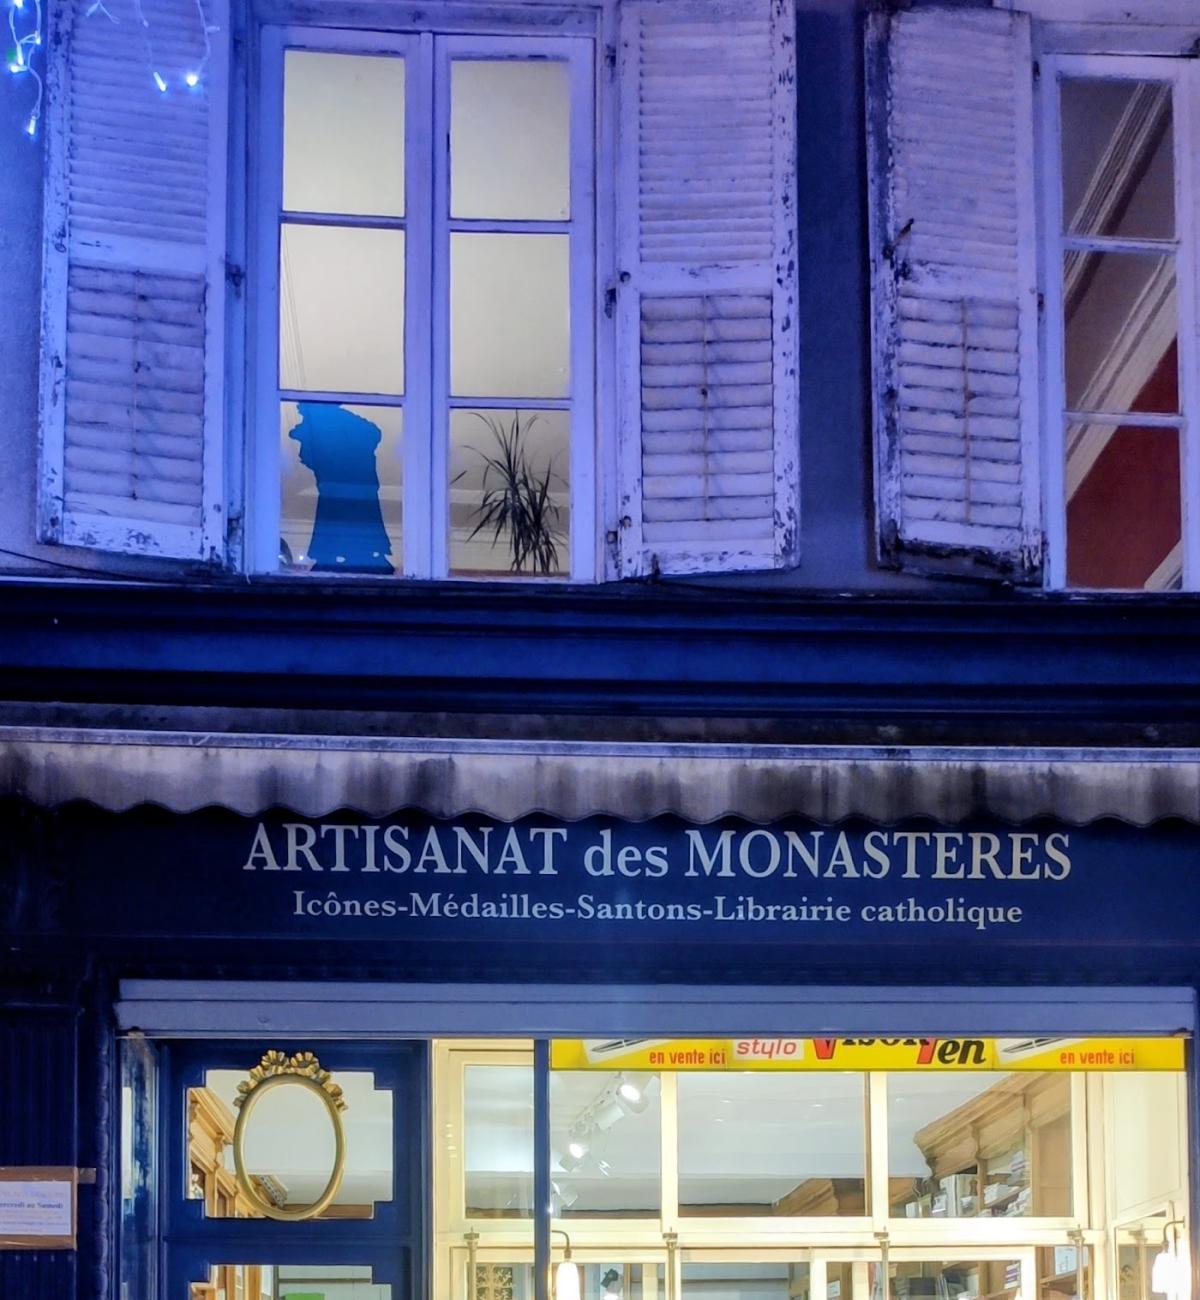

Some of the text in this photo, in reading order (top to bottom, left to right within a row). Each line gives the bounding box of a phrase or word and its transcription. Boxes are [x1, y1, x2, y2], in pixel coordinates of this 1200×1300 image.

[242, 822, 1072, 880] ARTISANAT des MONASTERES
[292, 890, 1023, 930] Icônes-Médailles-Santons-Librairie catholique
[649, 1048, 726, 1064] en vente ici
[736, 1038, 797, 1059] stylo
[1060, 1048, 1135, 1064] en vente ici
